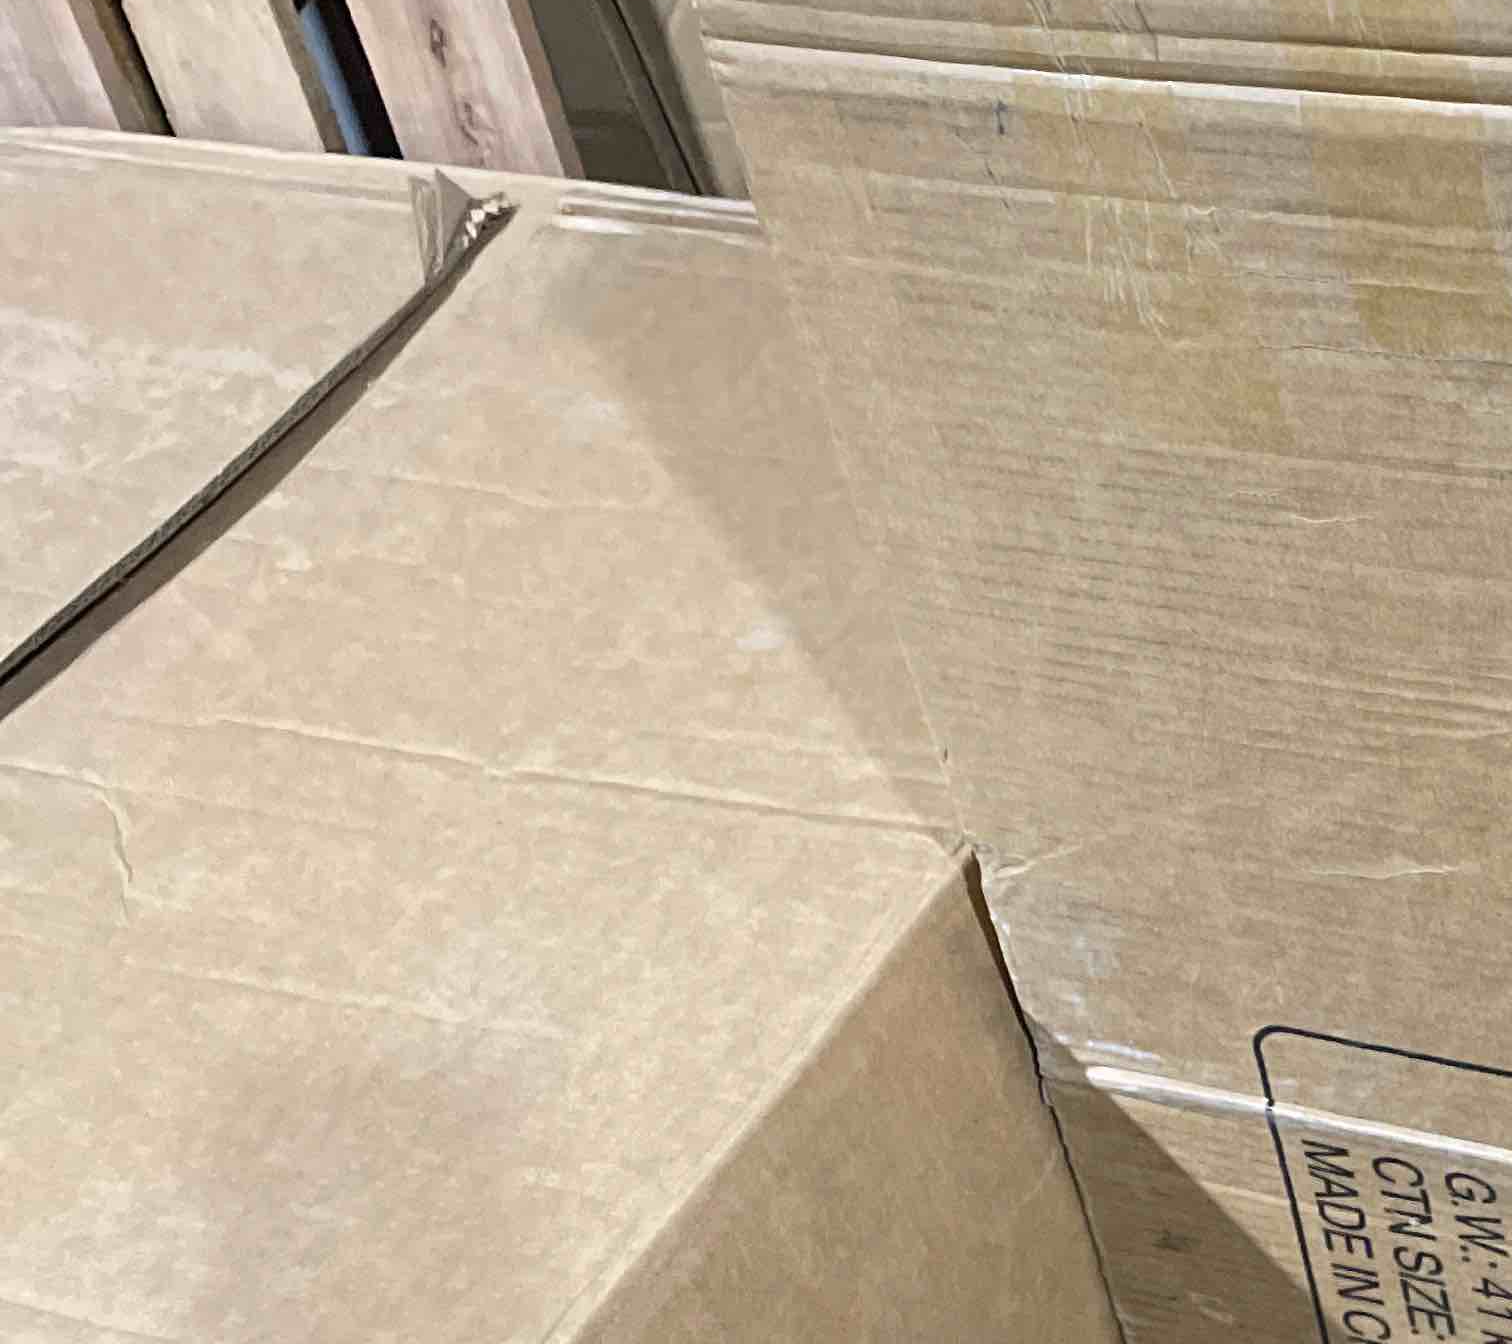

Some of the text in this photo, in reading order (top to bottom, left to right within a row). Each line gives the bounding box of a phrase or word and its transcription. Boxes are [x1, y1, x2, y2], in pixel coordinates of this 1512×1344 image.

[1301, 1139, 1375, 1260] MADE
[1371, 1156, 1438, 1243] CTN
[1331, 1261, 1386, 1307] IN
[1393, 1244, 1457, 1343] SIZE:
